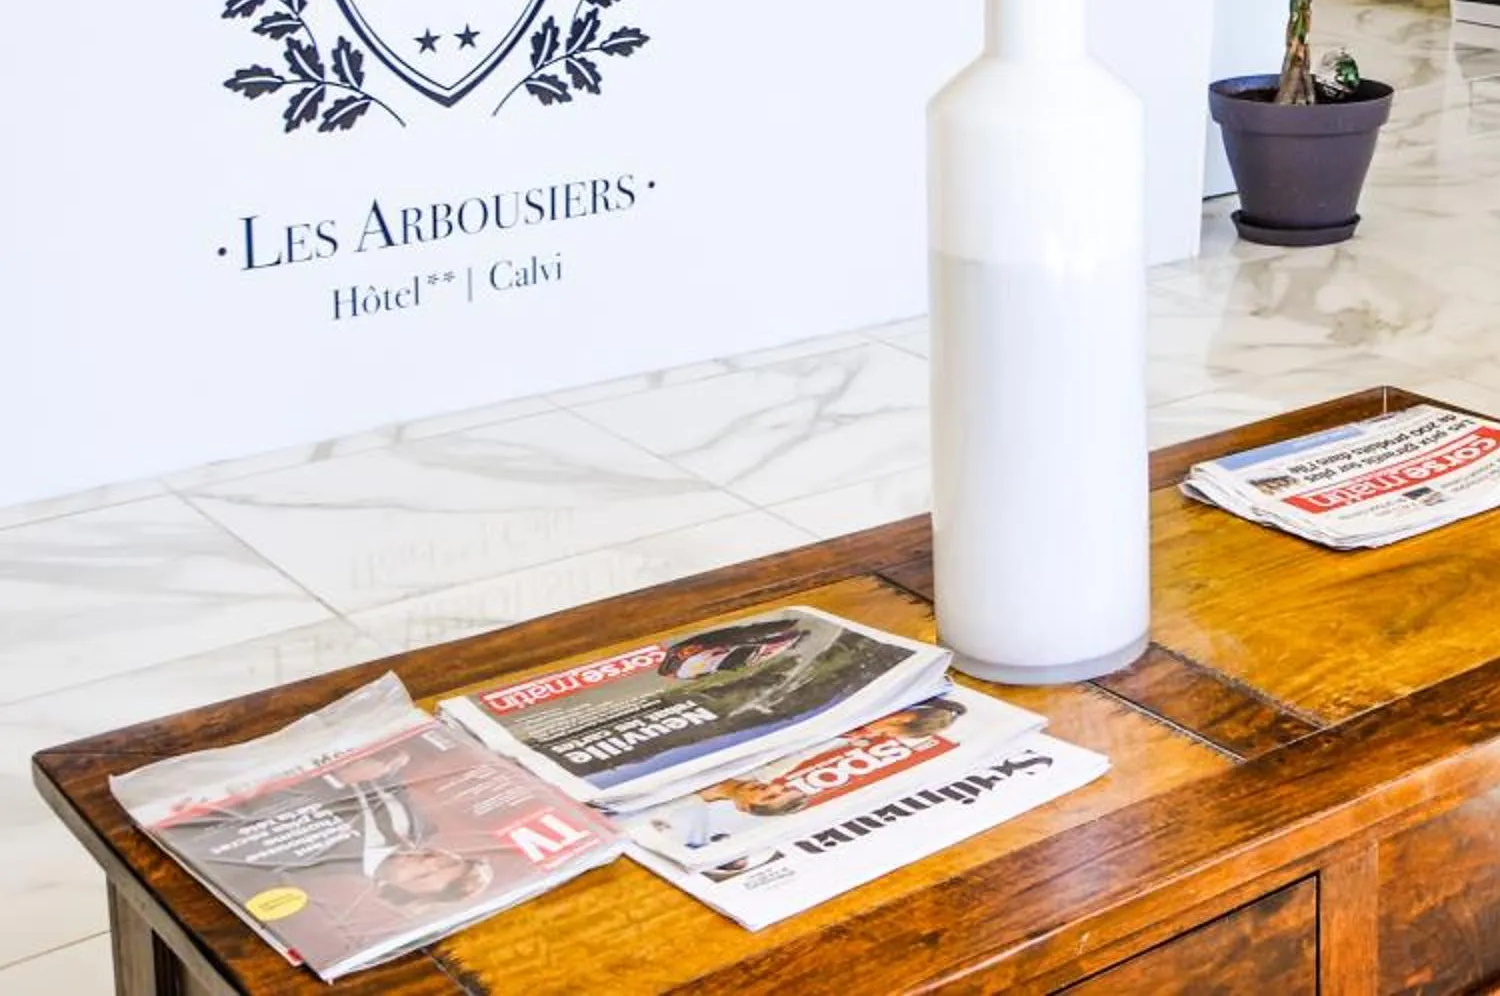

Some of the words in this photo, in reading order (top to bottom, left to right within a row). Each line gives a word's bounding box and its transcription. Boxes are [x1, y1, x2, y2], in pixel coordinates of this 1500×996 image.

[354, 173, 637, 253] ARBOUSIERS
[489, 252, 563, 292] Calvi
[565, 706, 719, 765] Neuville
[793, 748, 1054, 855] Settimana
[510, 812, 593, 864] TV
